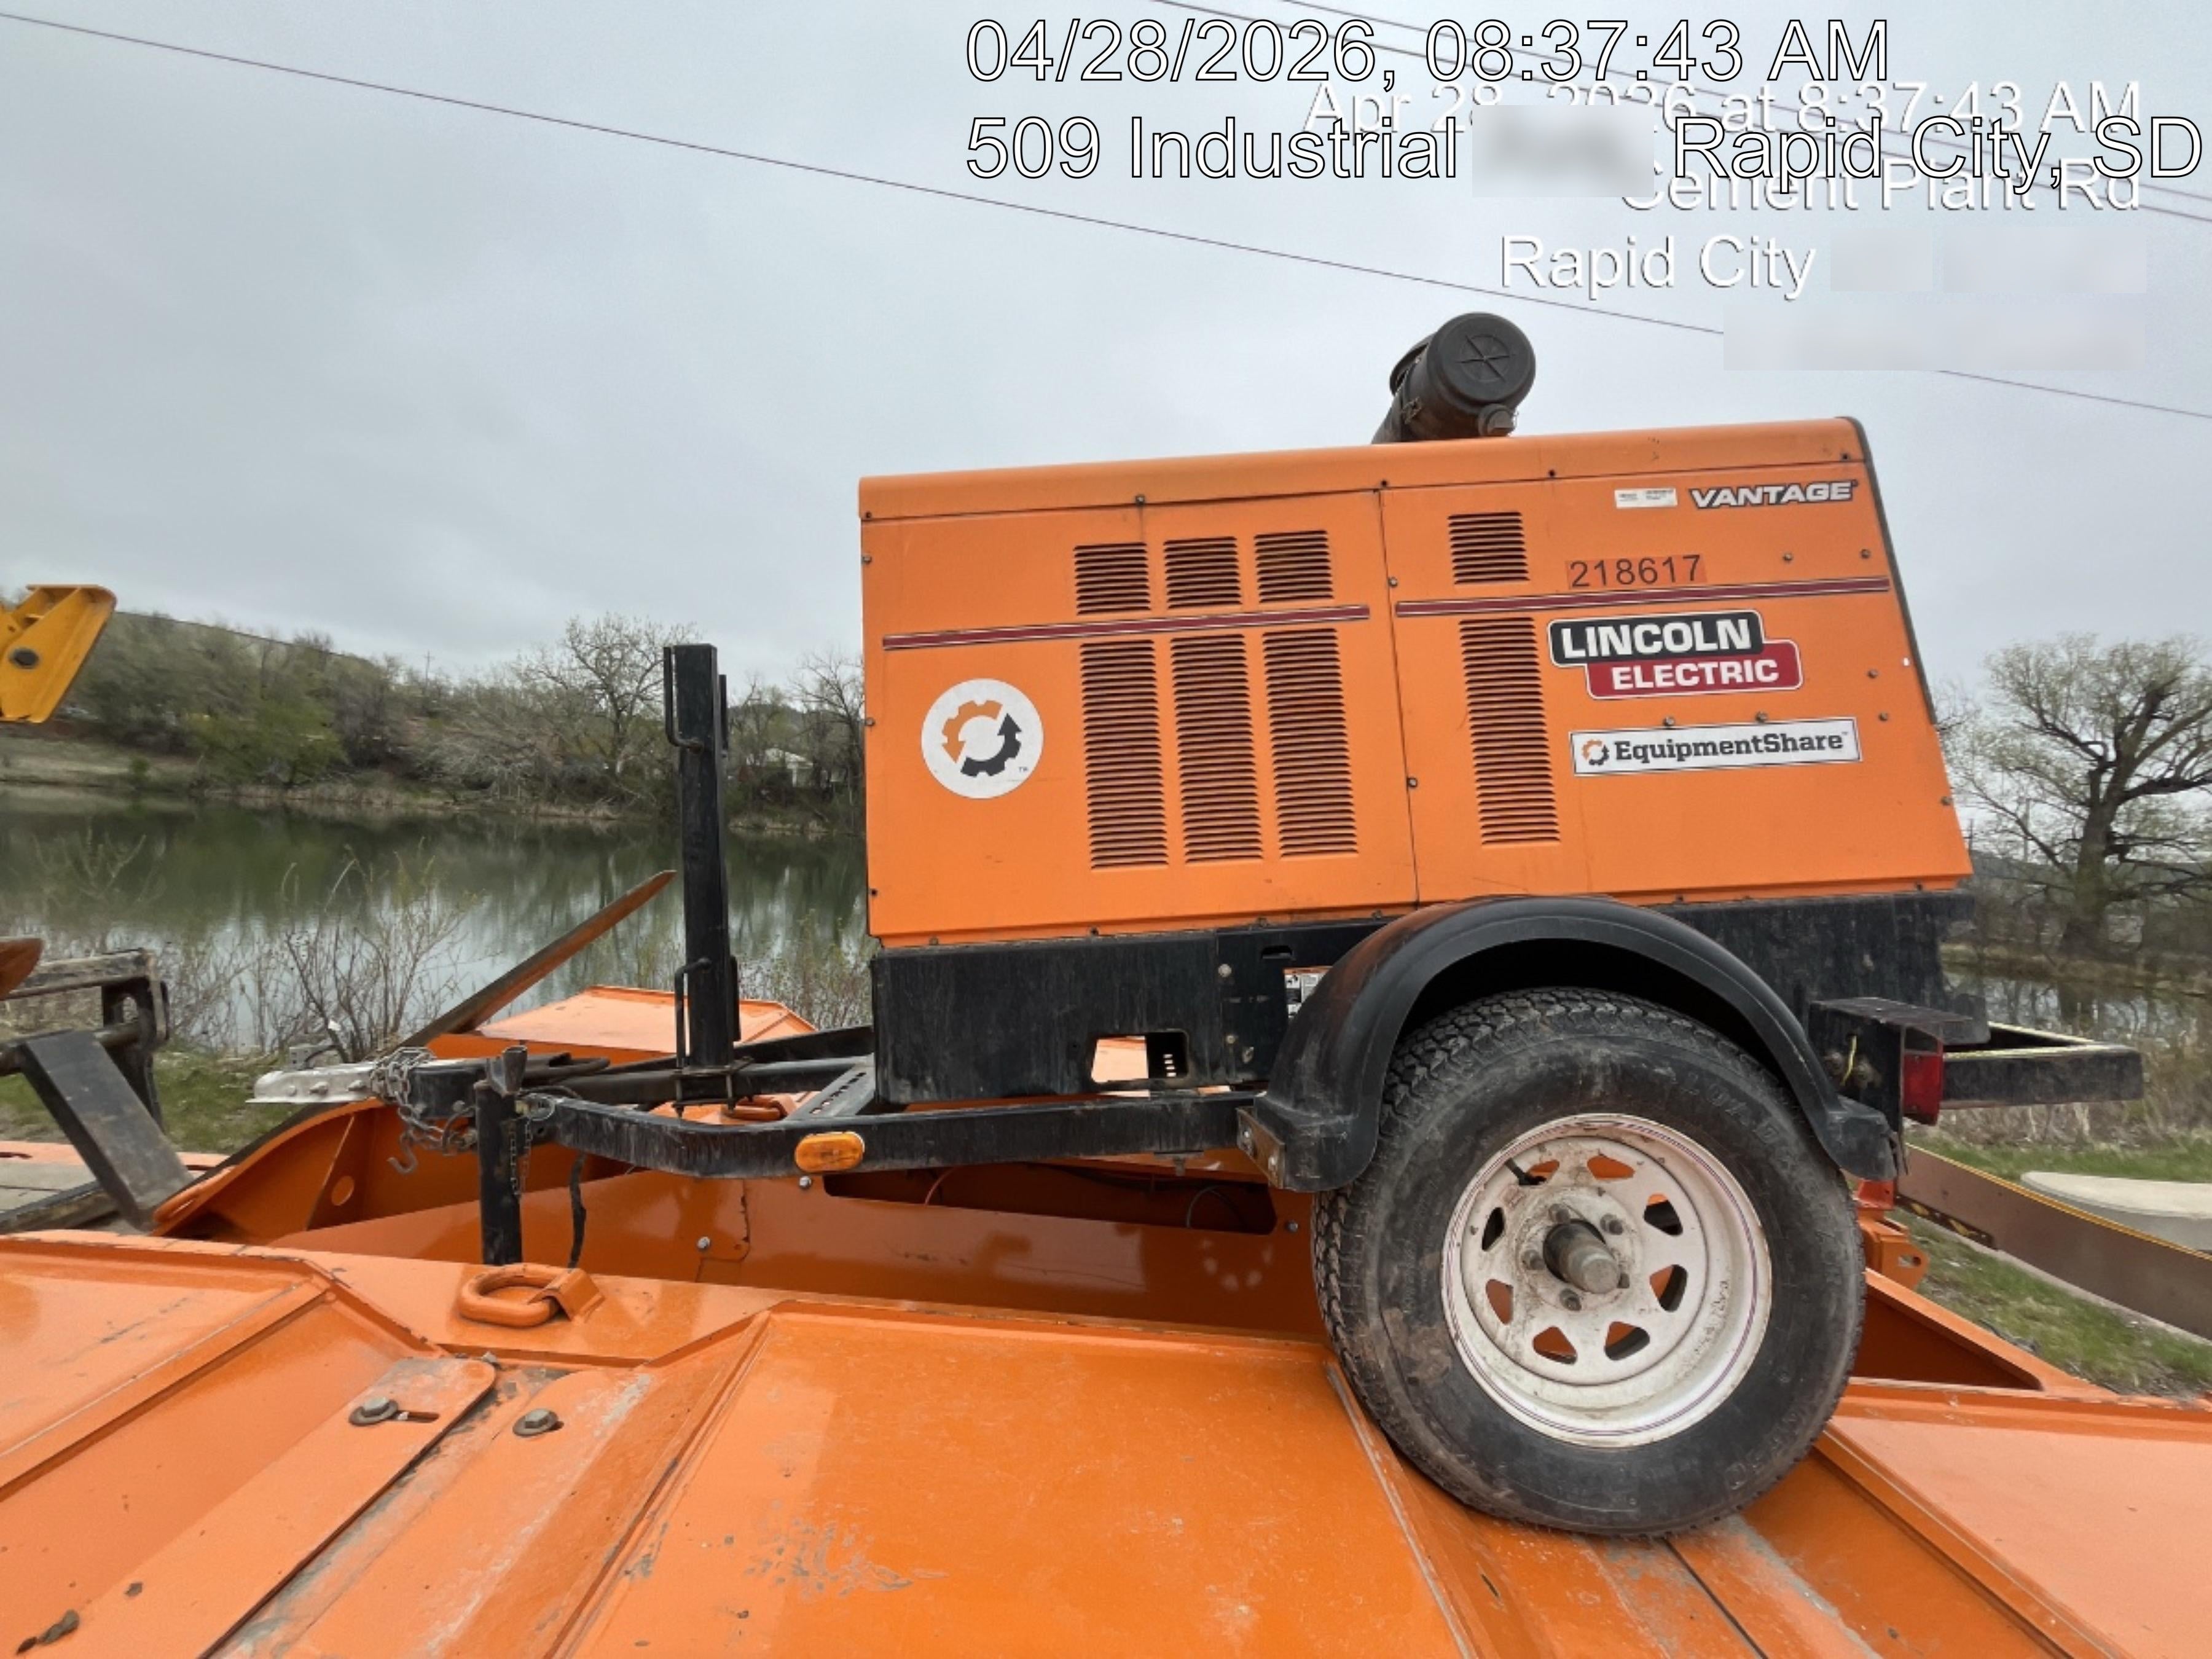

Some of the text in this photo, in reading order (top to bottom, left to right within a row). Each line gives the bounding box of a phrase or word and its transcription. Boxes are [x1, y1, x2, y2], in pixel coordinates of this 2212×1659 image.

[1690, 481, 1853, 509] VANTAGE
[1569, 554, 1701, 588] 218617
[1561, 618, 1752, 658] LINCOLN
[1612, 659, 1779, 690] ELECTRIC
[1615, 733, 1843, 762] EquipmentShare
